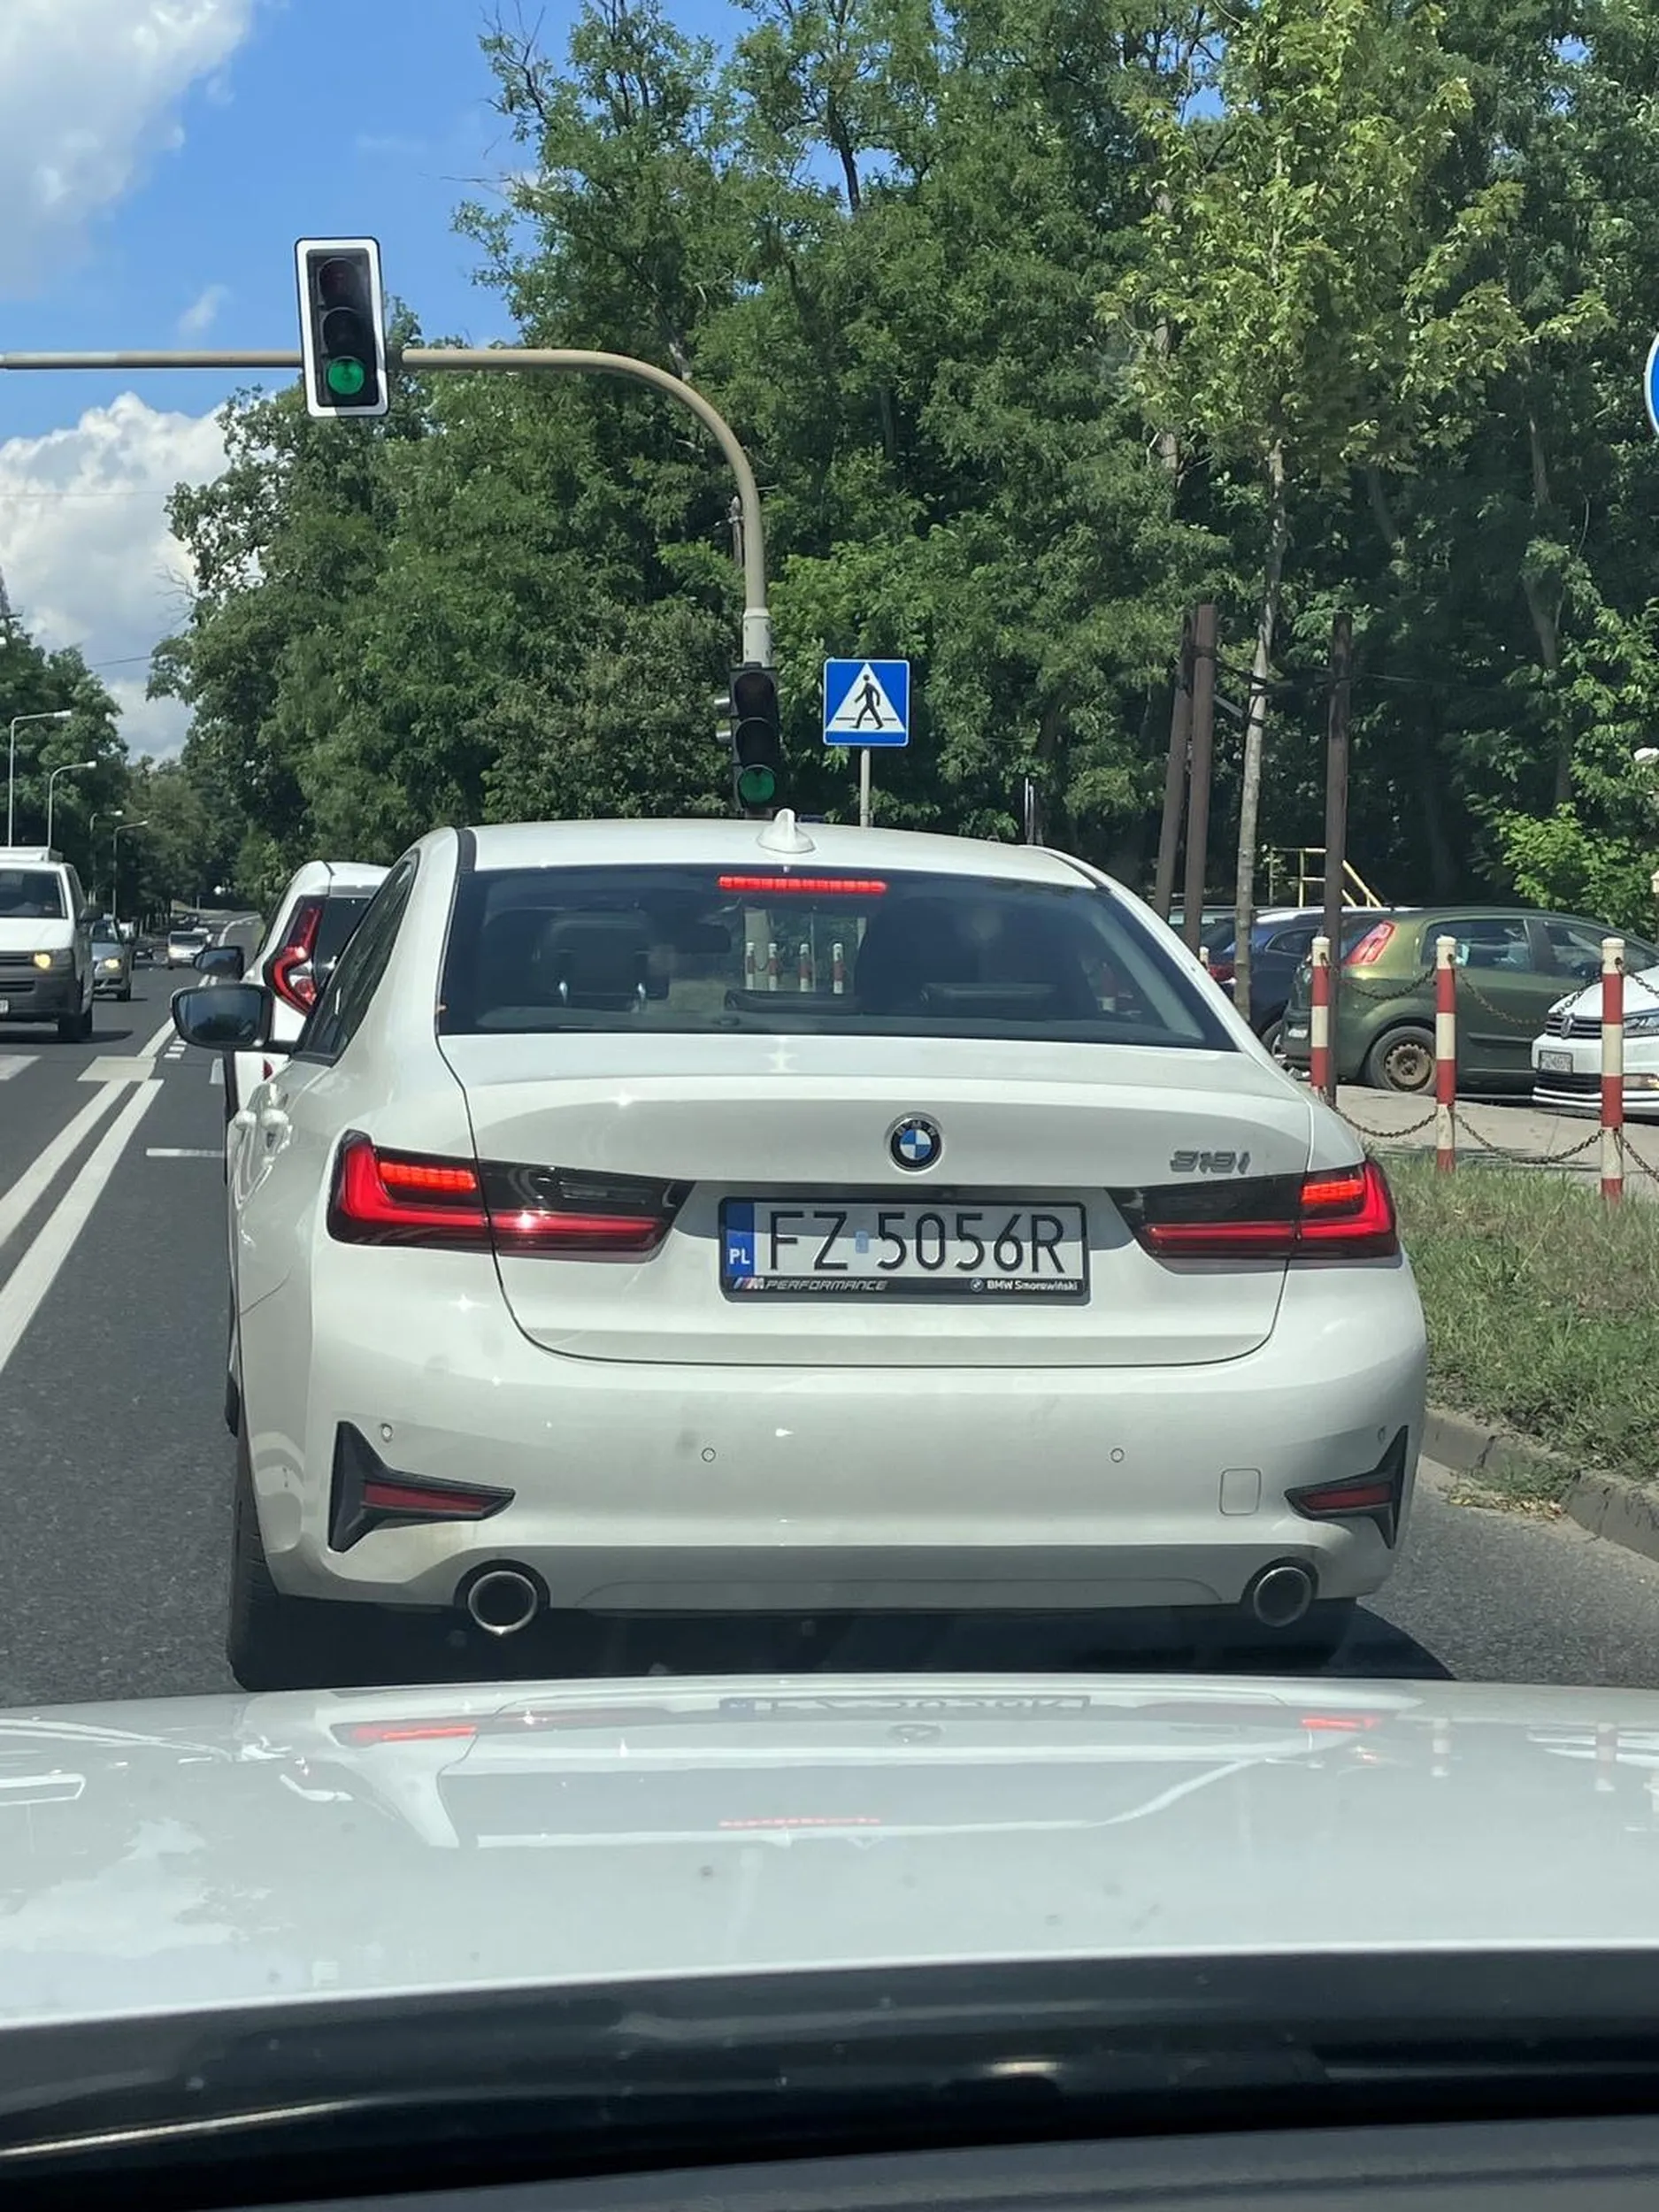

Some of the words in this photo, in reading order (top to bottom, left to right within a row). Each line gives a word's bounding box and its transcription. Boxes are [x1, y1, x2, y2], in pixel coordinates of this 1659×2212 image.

[895, 1120, 936, 1136] BMW
[770, 1210, 849, 1271] FZ
[877, 1211, 1064, 1273] 5056R
[729, 1245, 750, 1264] PL
[765, 1279, 888, 1291] PERFORMANCE
[987, 1280, 1013, 1290] BMW
